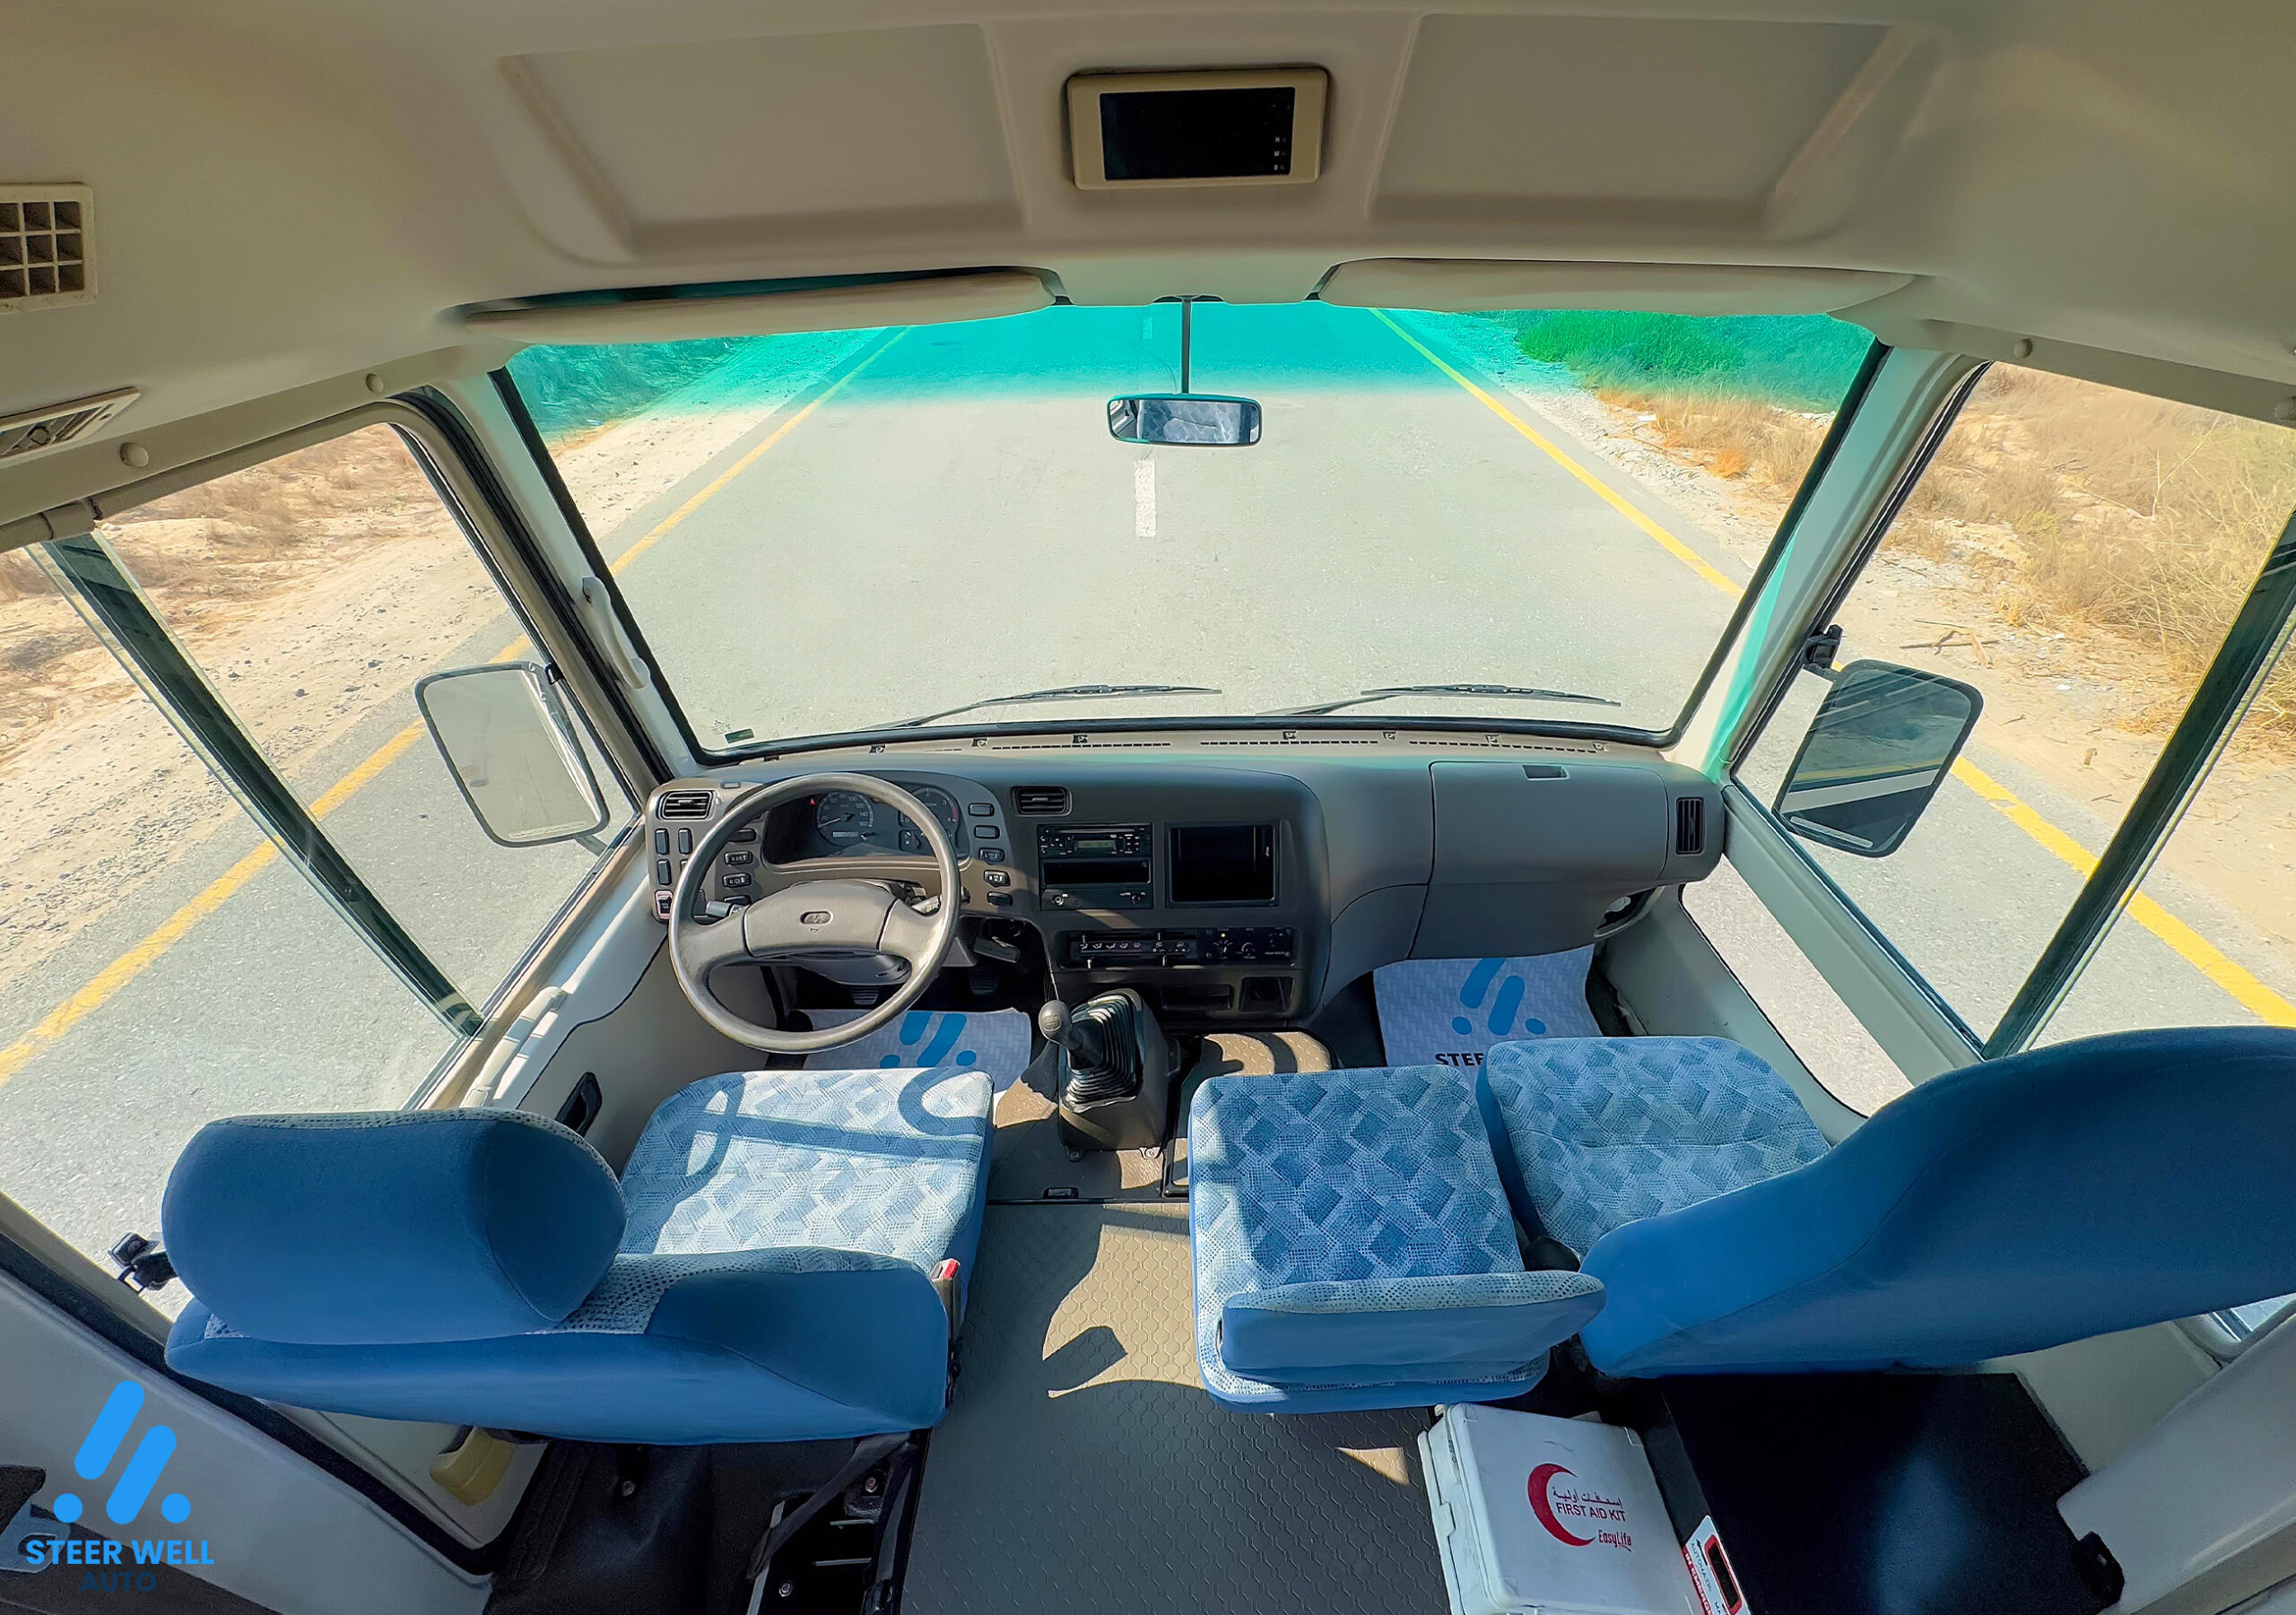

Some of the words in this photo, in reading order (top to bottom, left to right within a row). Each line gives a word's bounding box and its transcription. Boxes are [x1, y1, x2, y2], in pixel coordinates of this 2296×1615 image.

[1556, 1502, 1587, 1516] FIRST
[1590, 1506, 1607, 1519] AID
[1609, 1509, 1626, 1522] KIT
[1598, 1529, 1631, 1548] EasyLife
